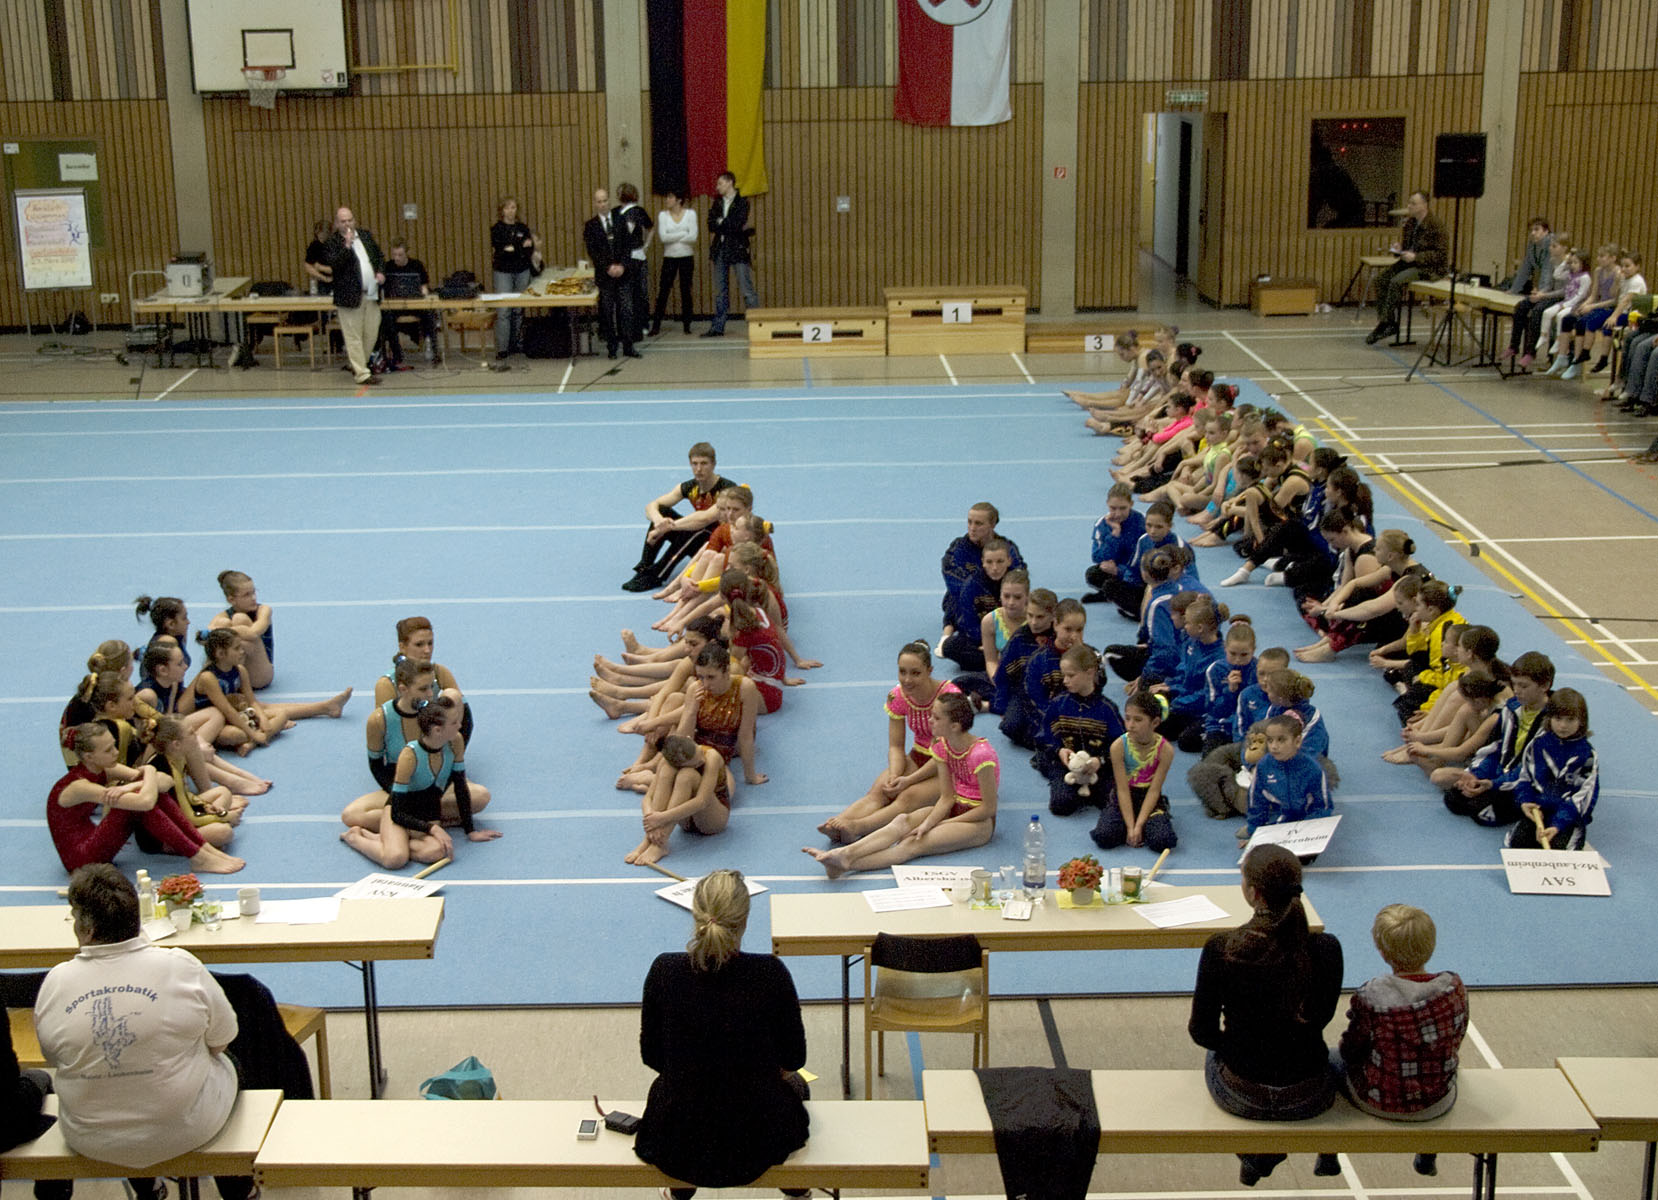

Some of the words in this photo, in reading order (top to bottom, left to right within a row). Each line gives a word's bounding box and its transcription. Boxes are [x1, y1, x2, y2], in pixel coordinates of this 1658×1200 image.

[952, 308, 960, 322] 1
[811, 327, 821, 341] 2
[1094, 336, 1103, 350] 3
[1540, 877, 1576, 887] SAV
